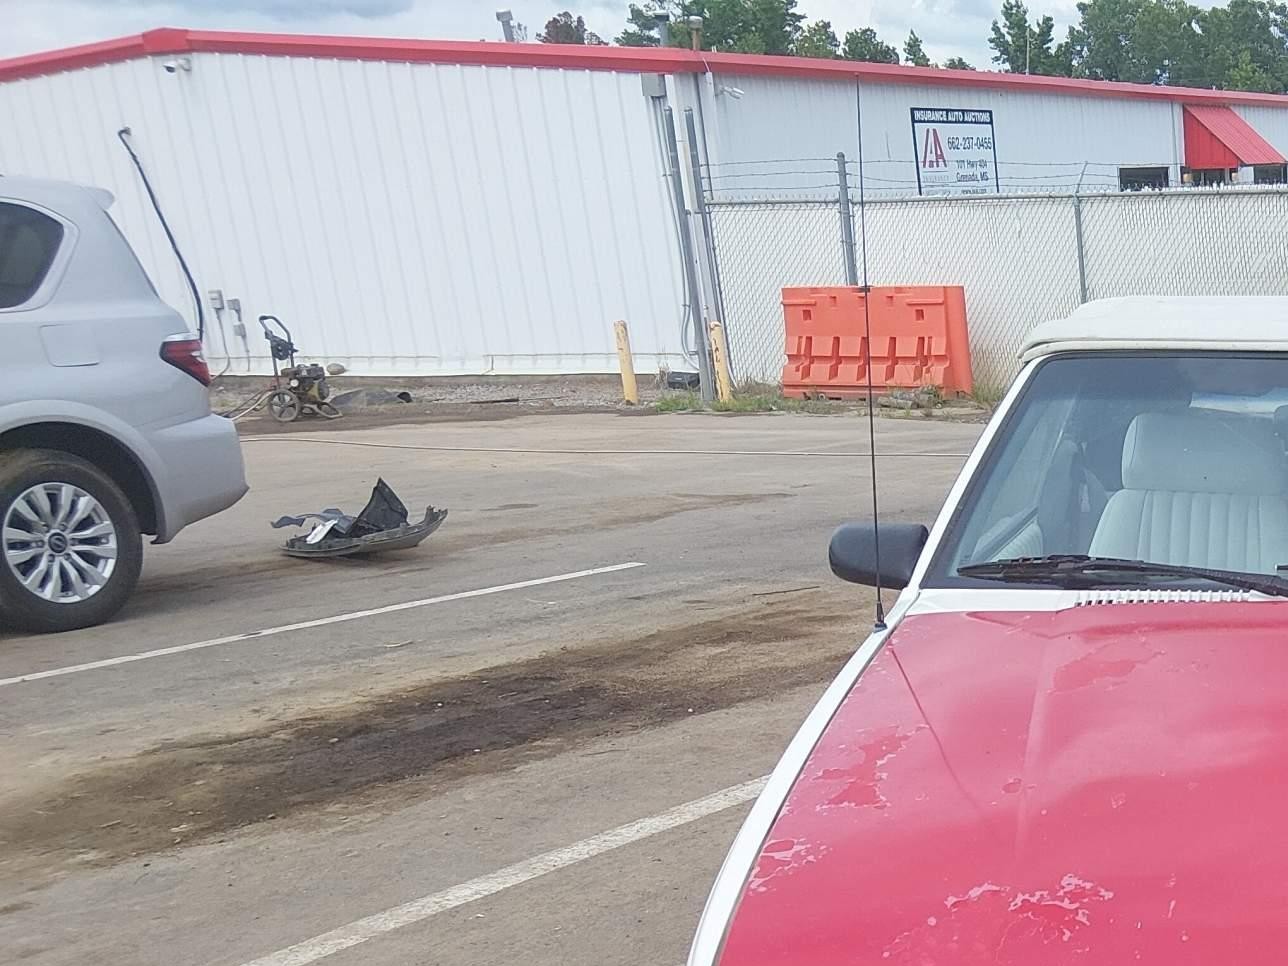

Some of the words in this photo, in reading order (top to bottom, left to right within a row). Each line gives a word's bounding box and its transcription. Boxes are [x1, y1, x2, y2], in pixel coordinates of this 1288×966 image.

[914, 110, 947, 121] INSURANCE
[947, 111, 963, 122] AUTO
[964, 112, 991, 123] AUCTIONS
